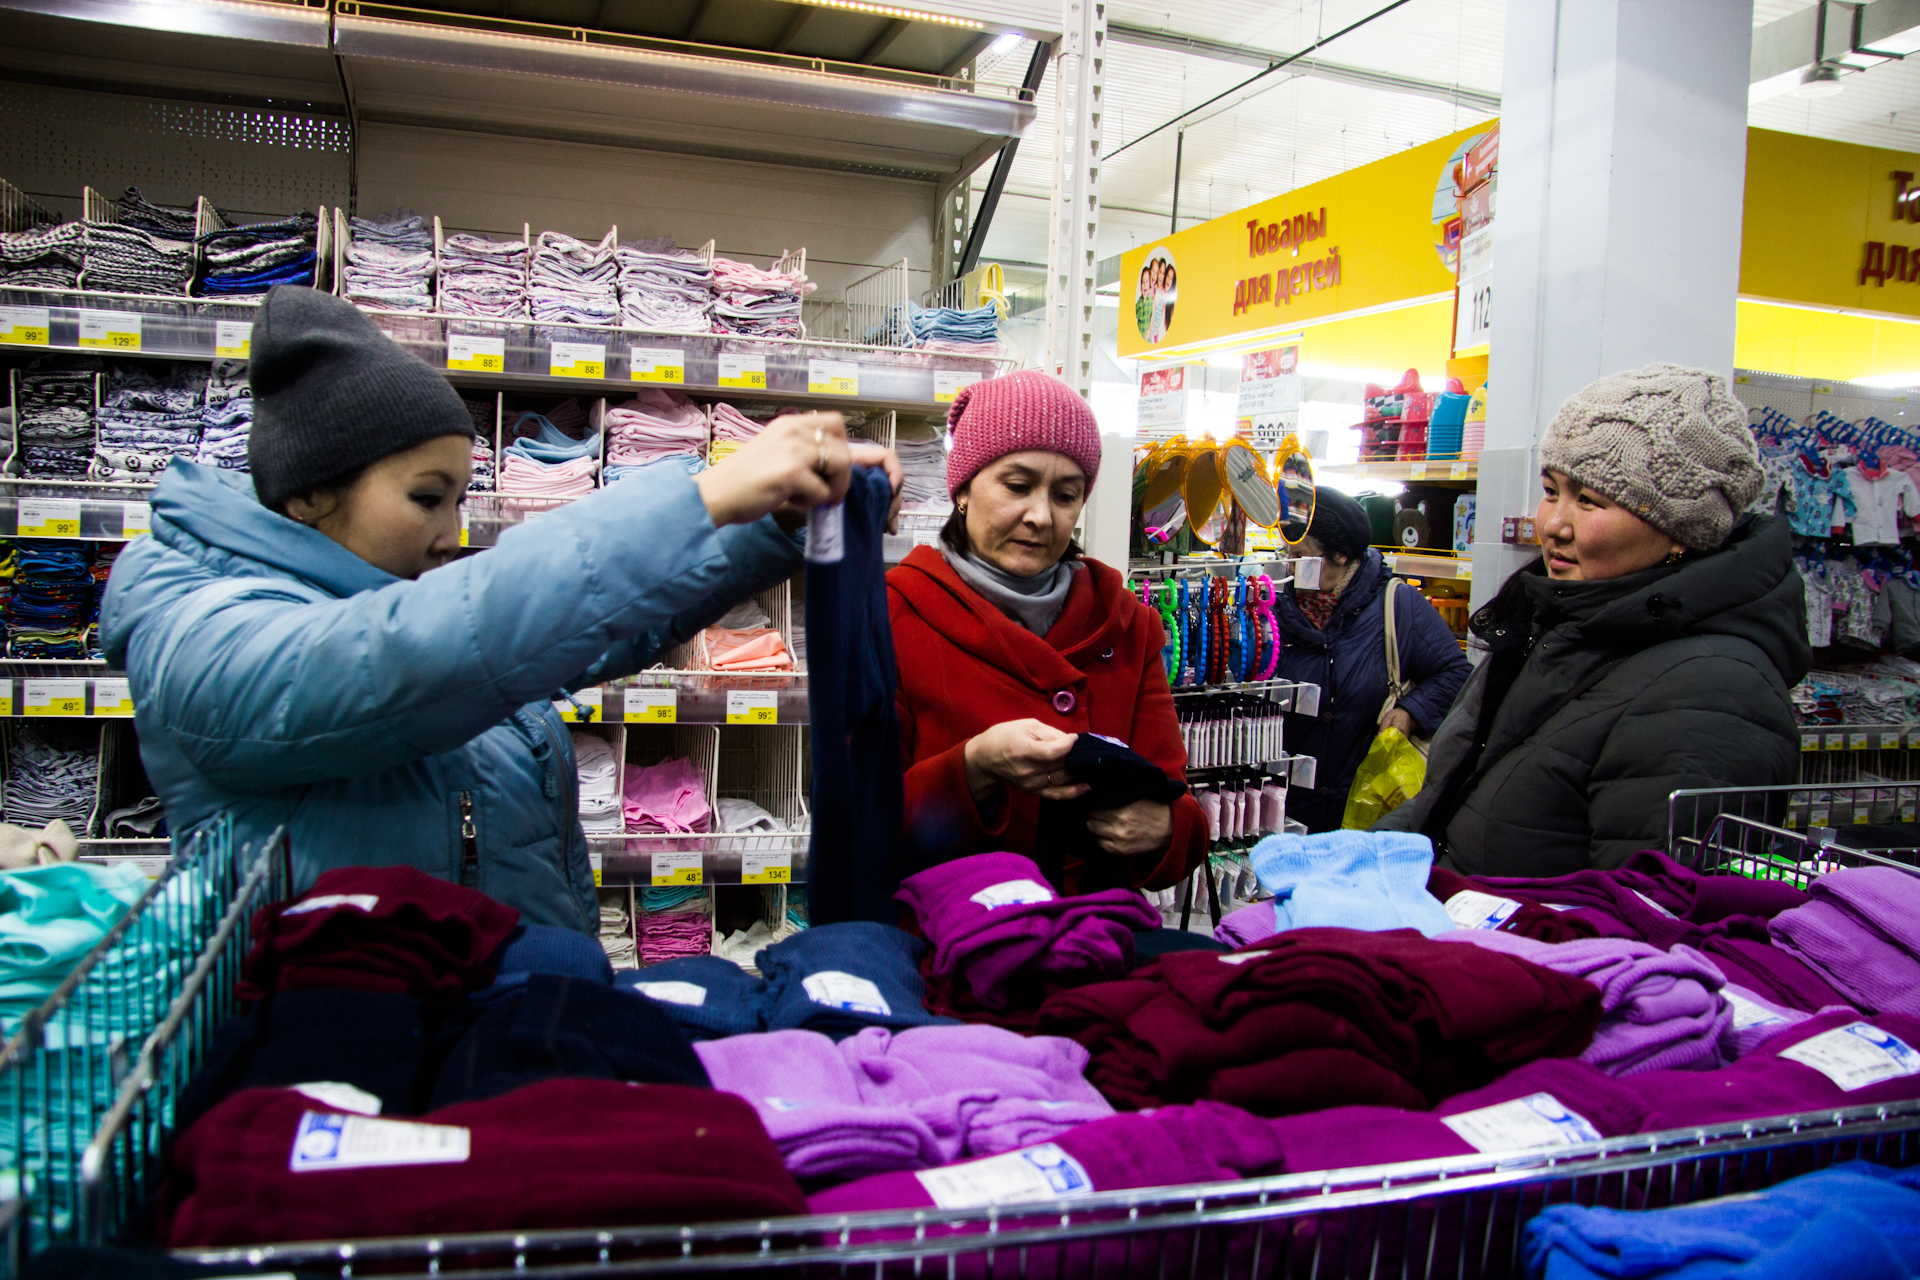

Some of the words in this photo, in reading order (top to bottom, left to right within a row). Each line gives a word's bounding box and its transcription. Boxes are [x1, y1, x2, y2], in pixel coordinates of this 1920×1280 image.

[1246, 207, 1326, 259] Товары
[1233, 273, 1270, 317] для
[1274, 245, 1341, 307] детей
[1473, 285, 1491, 333] 112
[25, 331, 37, 341] 99
[113, 337, 130, 347] 129
[483, 358, 494, 368] 88
[584, 365, 595, 375] 88
[664, 369, 674, 379] 88
[751, 374, 761, 384] 88
[839, 381, 849, 391] 88
[57, 523, 69, 533] 99
[62, 702, 74, 712] 49
[657, 709, 667, 718] 98
[757, 711, 768, 720] 99
[685, 873, 696, 882] 48
[768, 870, 782, 879] 134
